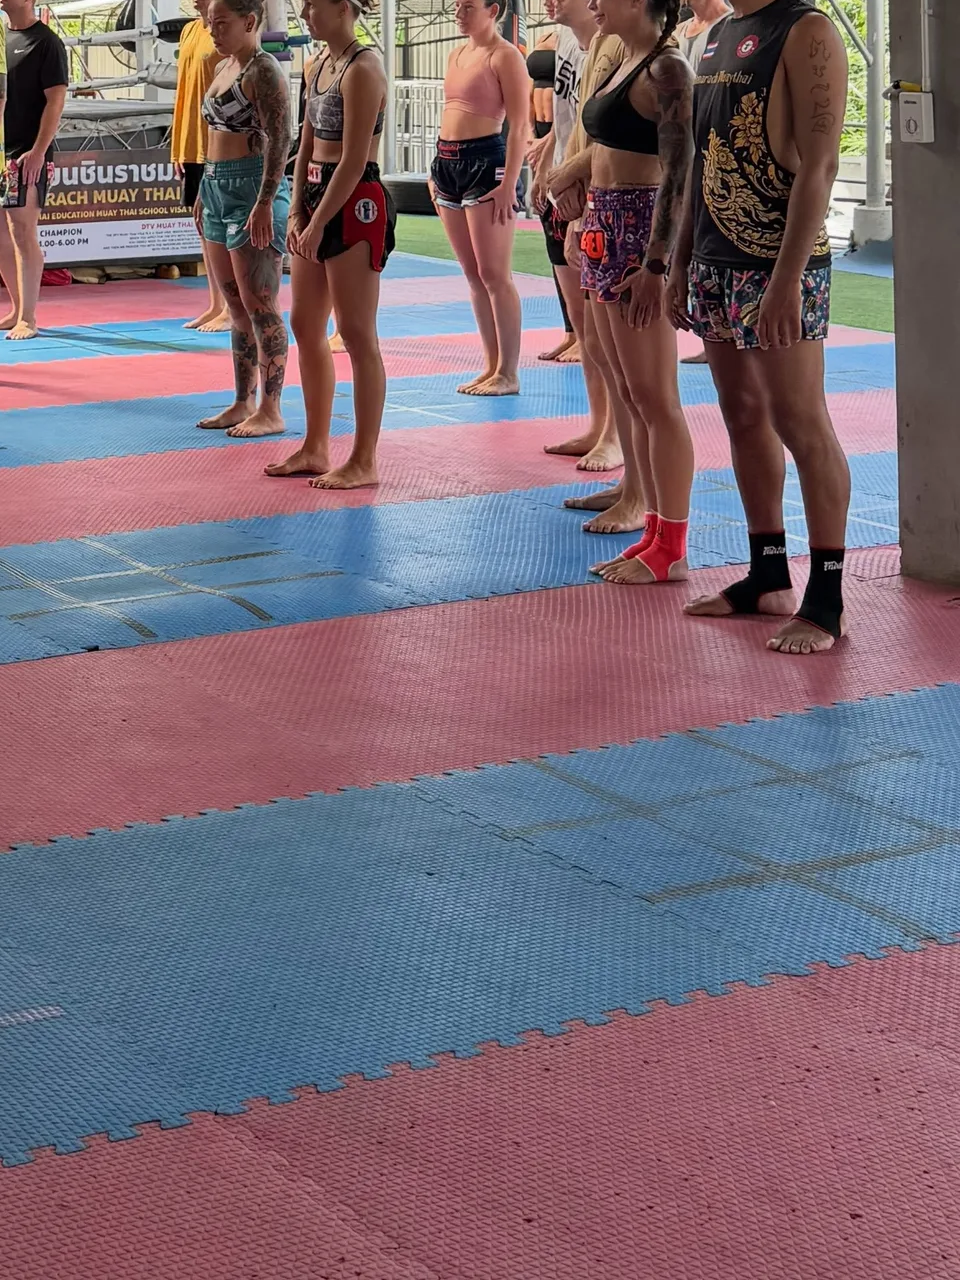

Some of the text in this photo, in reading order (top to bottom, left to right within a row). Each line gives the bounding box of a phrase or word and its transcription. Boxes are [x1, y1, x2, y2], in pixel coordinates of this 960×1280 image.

[93, 188, 139, 205] MUAY
[143, 186, 181, 202] THAI
[51, 210, 95, 220] EDUCATION
[96, 208, 118, 218] MUAY
[120, 208, 137, 216] THAI
[138, 206, 168, 215] SCHOOL
[169, 205, 187, 214] VISA
[156, 221, 176, 230] MUAY
[39, 228, 83, 238] CHAMPION
[77, 237, 89, 246] PM
